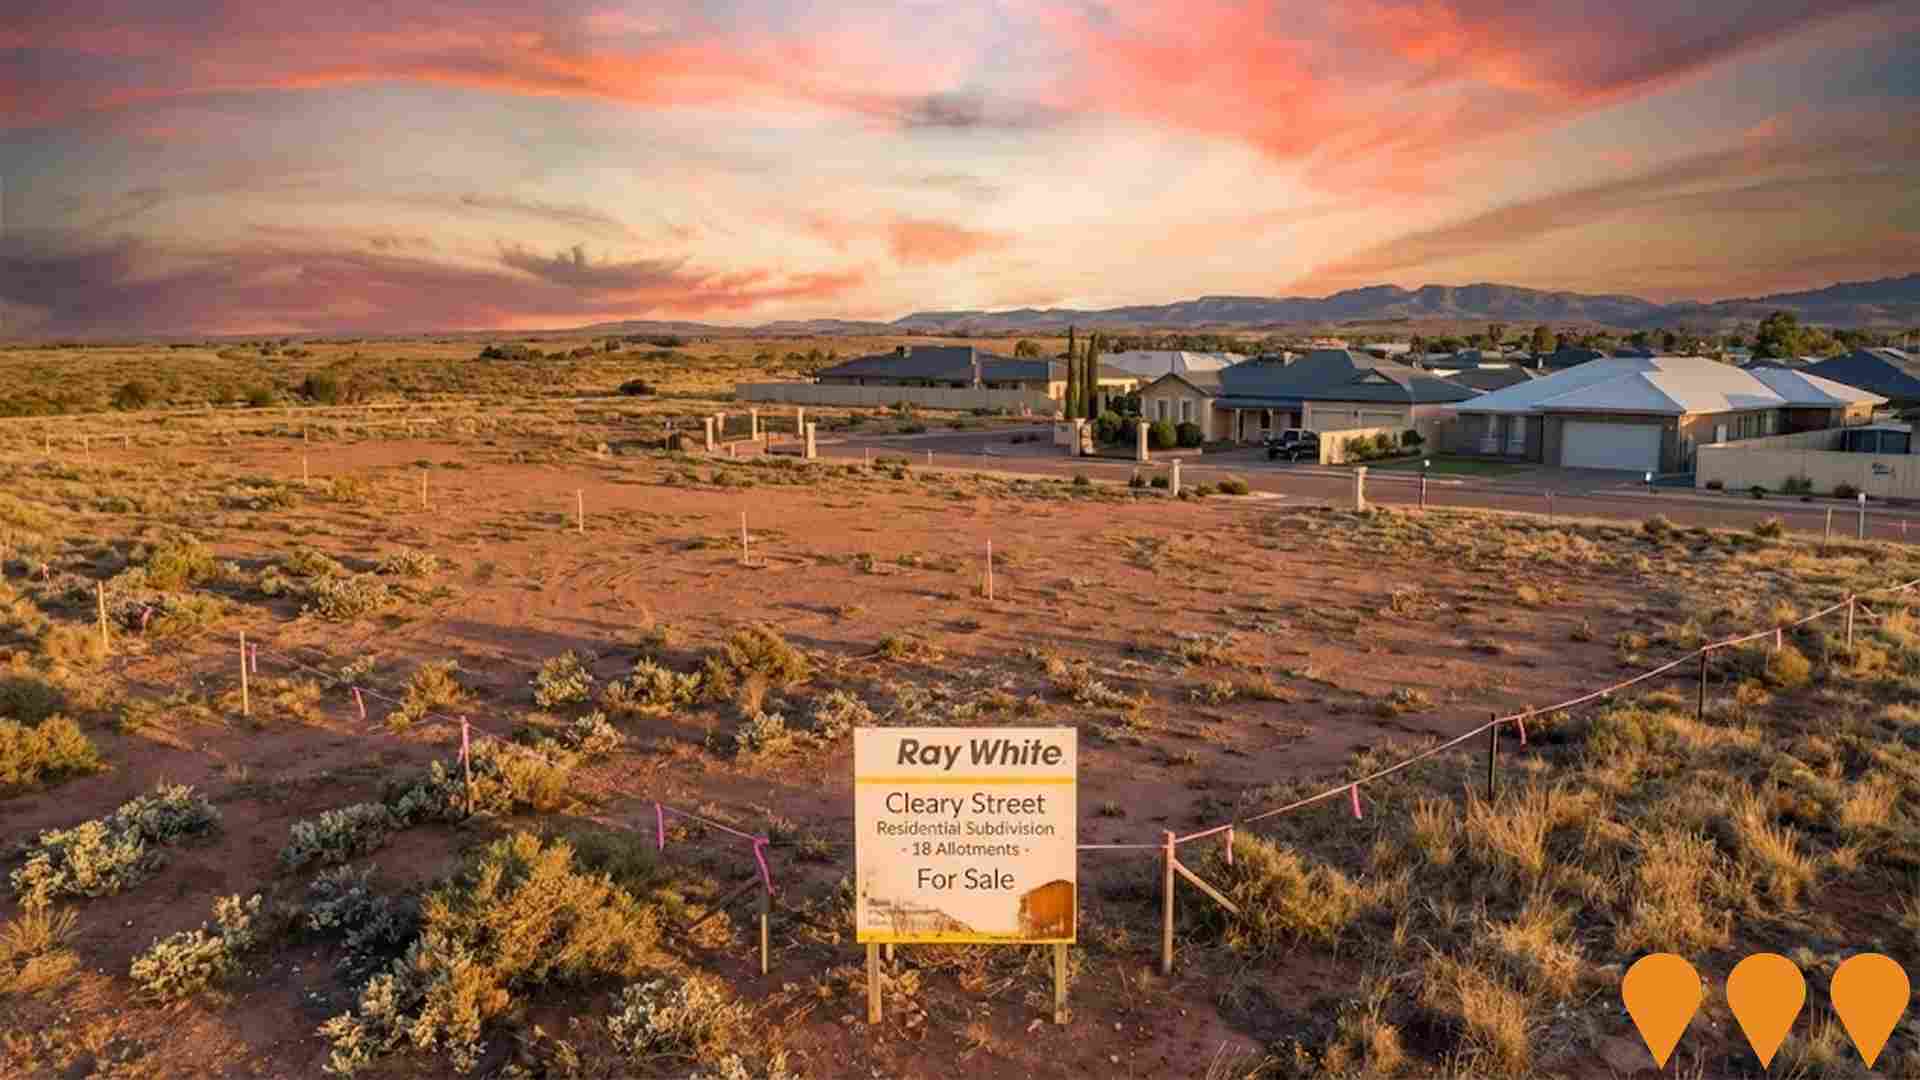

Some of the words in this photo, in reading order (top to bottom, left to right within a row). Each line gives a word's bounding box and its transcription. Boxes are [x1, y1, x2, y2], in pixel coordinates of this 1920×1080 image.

[897, 738, 963, 770] Ray
[970, 738, 1063, 766] White
[885, 791, 964, 818] Cleary
[971, 791, 1046, 815] Street
[876, 820, 961, 836] Residential
[965, 820, 1055, 836] Subdivision
[912, 841, 933, 856] 18
[935, 841, 1020, 856] Allotments
[917, 867, 957, 890] For
[964, 867, 1015, 890] Sale
